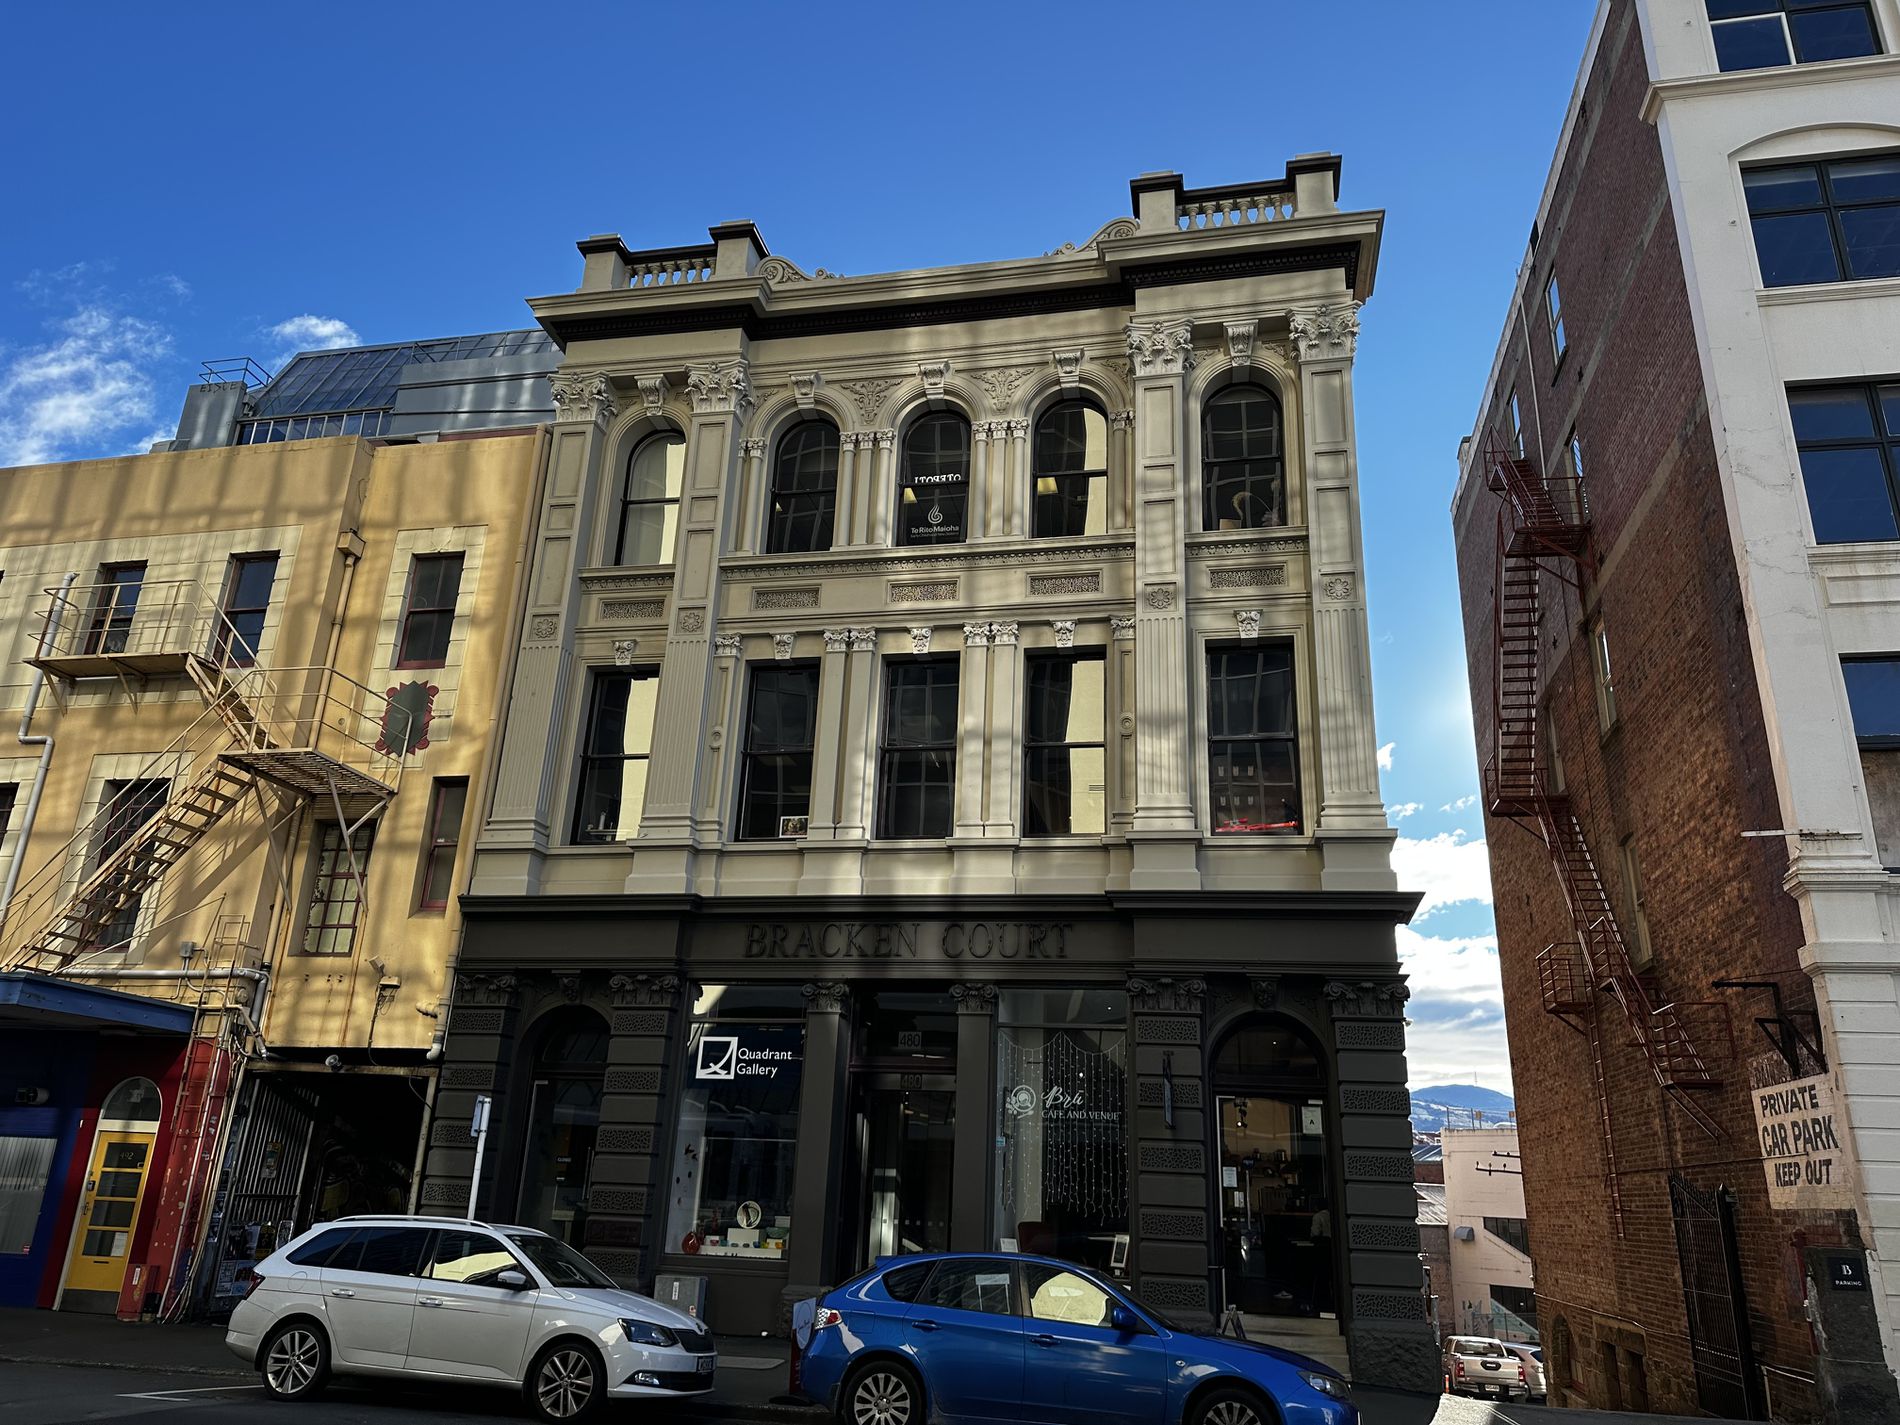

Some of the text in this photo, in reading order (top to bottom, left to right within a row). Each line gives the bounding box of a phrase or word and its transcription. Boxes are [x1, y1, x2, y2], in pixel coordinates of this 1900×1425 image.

[742, 923, 1074, 959] BRACKEN COURT
[900, 1033, 921, 1047] 480
[738, 1047, 792, 1060] Quadrant
[736, 1063, 778, 1079] Gallery
[901, 1074, 922, 1089] 480
[1759, 1084, 1819, 1118] PRIVATE
[1041, 1109, 1121, 1120] CAFE AND VENUE
[1762, 1115, 1839, 1157] CAR PARK
[119, 1151, 135, 1160] 492
[1774, 1158, 1832, 1187] KEEP OUT
[1841, 1264, 1853, 1275] B
